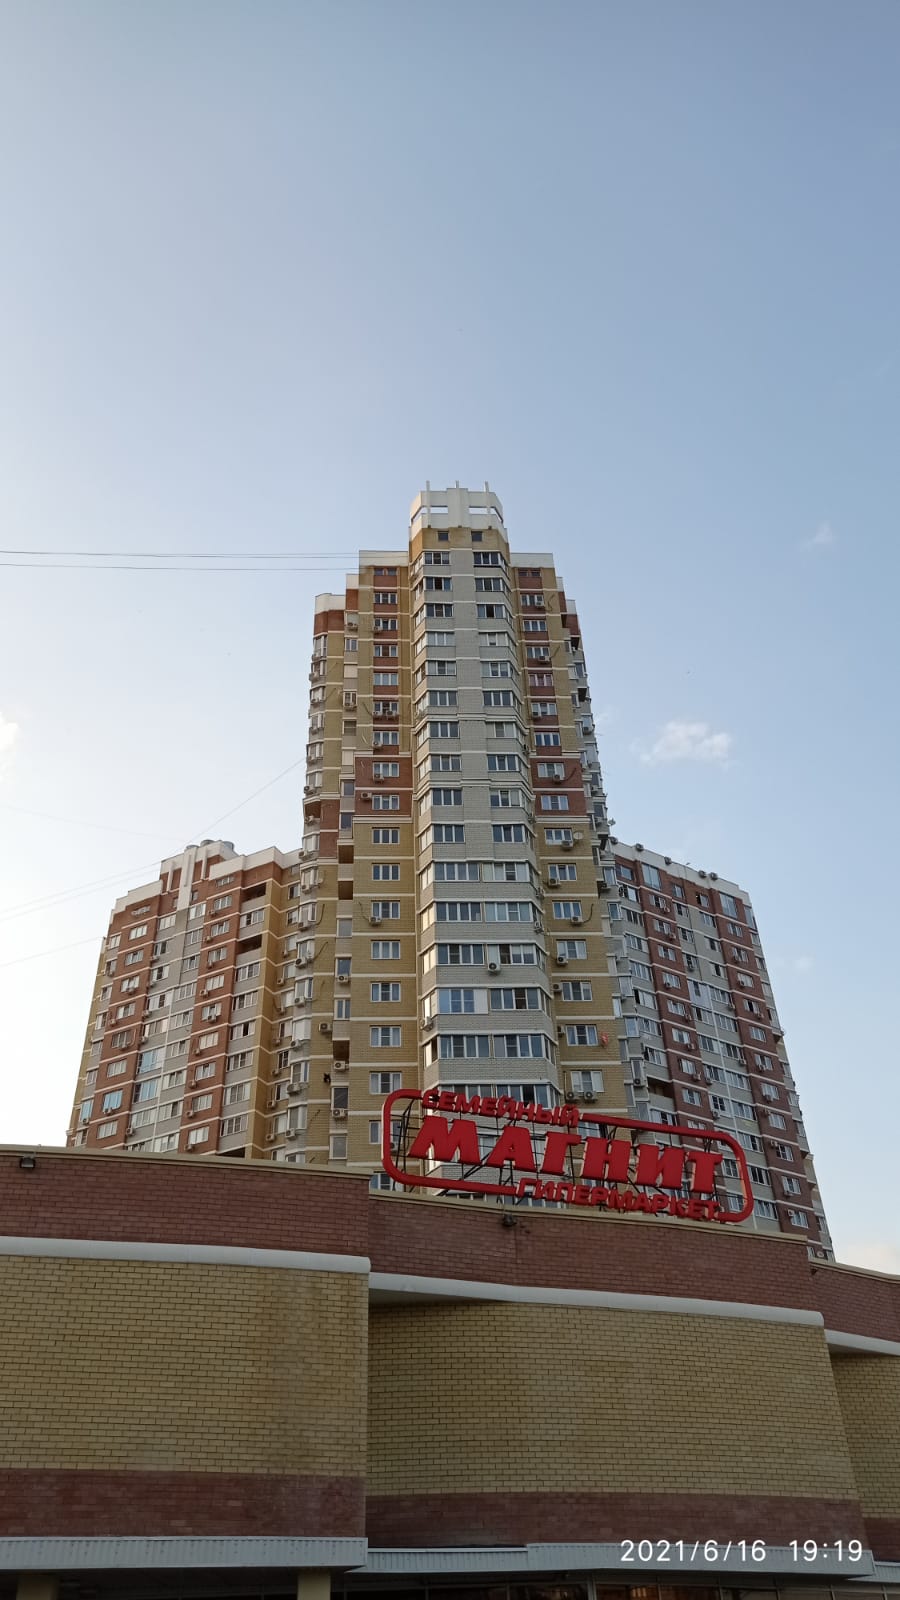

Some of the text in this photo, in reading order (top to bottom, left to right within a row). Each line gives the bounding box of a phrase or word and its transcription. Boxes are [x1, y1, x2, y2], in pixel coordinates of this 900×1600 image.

[423, 1089, 579, 1128] СЕМЕЙНЫЙ
[408, 1116, 723, 1194] МАГНИТ
[519, 1178, 719, 1220] ГИПЕРМАРКЕТ
